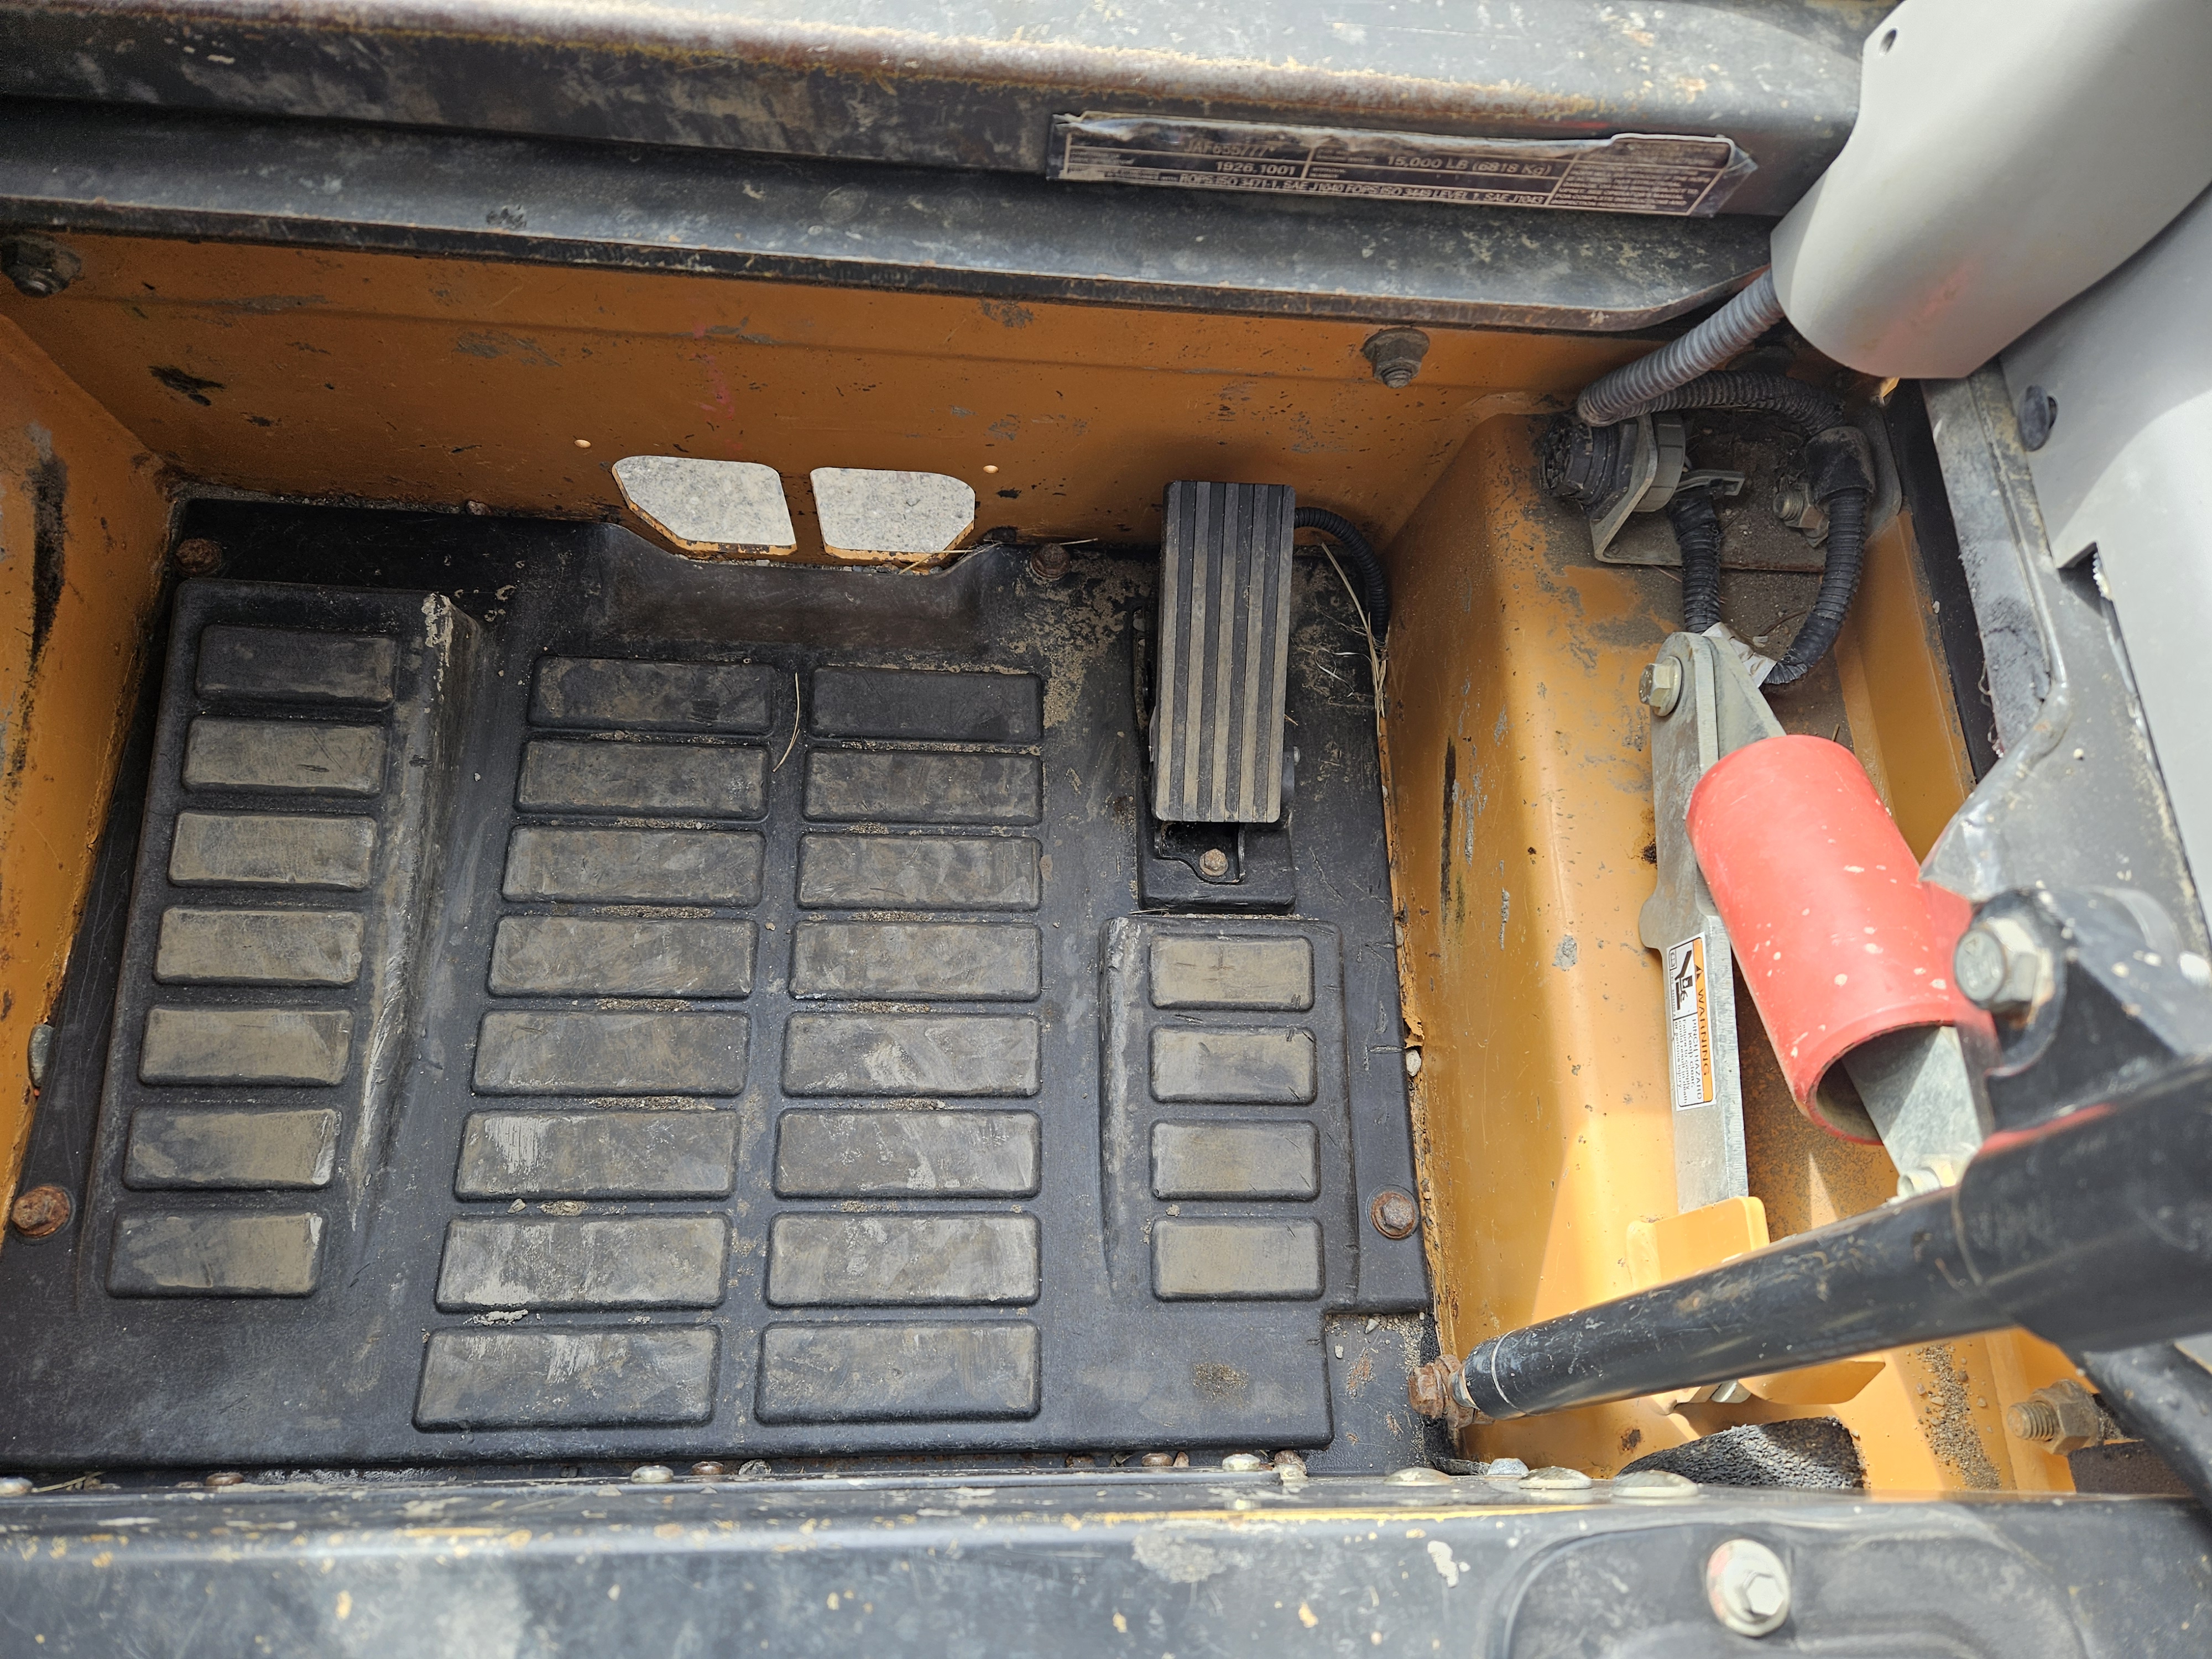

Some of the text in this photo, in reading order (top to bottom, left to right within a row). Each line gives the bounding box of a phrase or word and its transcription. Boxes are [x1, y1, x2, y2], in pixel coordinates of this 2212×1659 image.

[1216, 161, 1296, 176] 1926.1001
[1387, 156, 1552, 176] 15,000 LB (6818 Kg)
[1179, 174, 1214, 184] ROPS
[1215, 175, 1238, 186] ISO
[1282, 180, 1308, 191] SAE
[1310, 182, 1345, 193] J1040
[1345, 184, 1379, 194] FOPS
[1380, 186, 1402, 196] ISO
[1433, 190, 1468, 200] LEVEL
[1483, 193, 1510, 202] SAE
[1509, 195, 1545, 204] J1043
[1698, 989, 1710, 1076] WARNING
